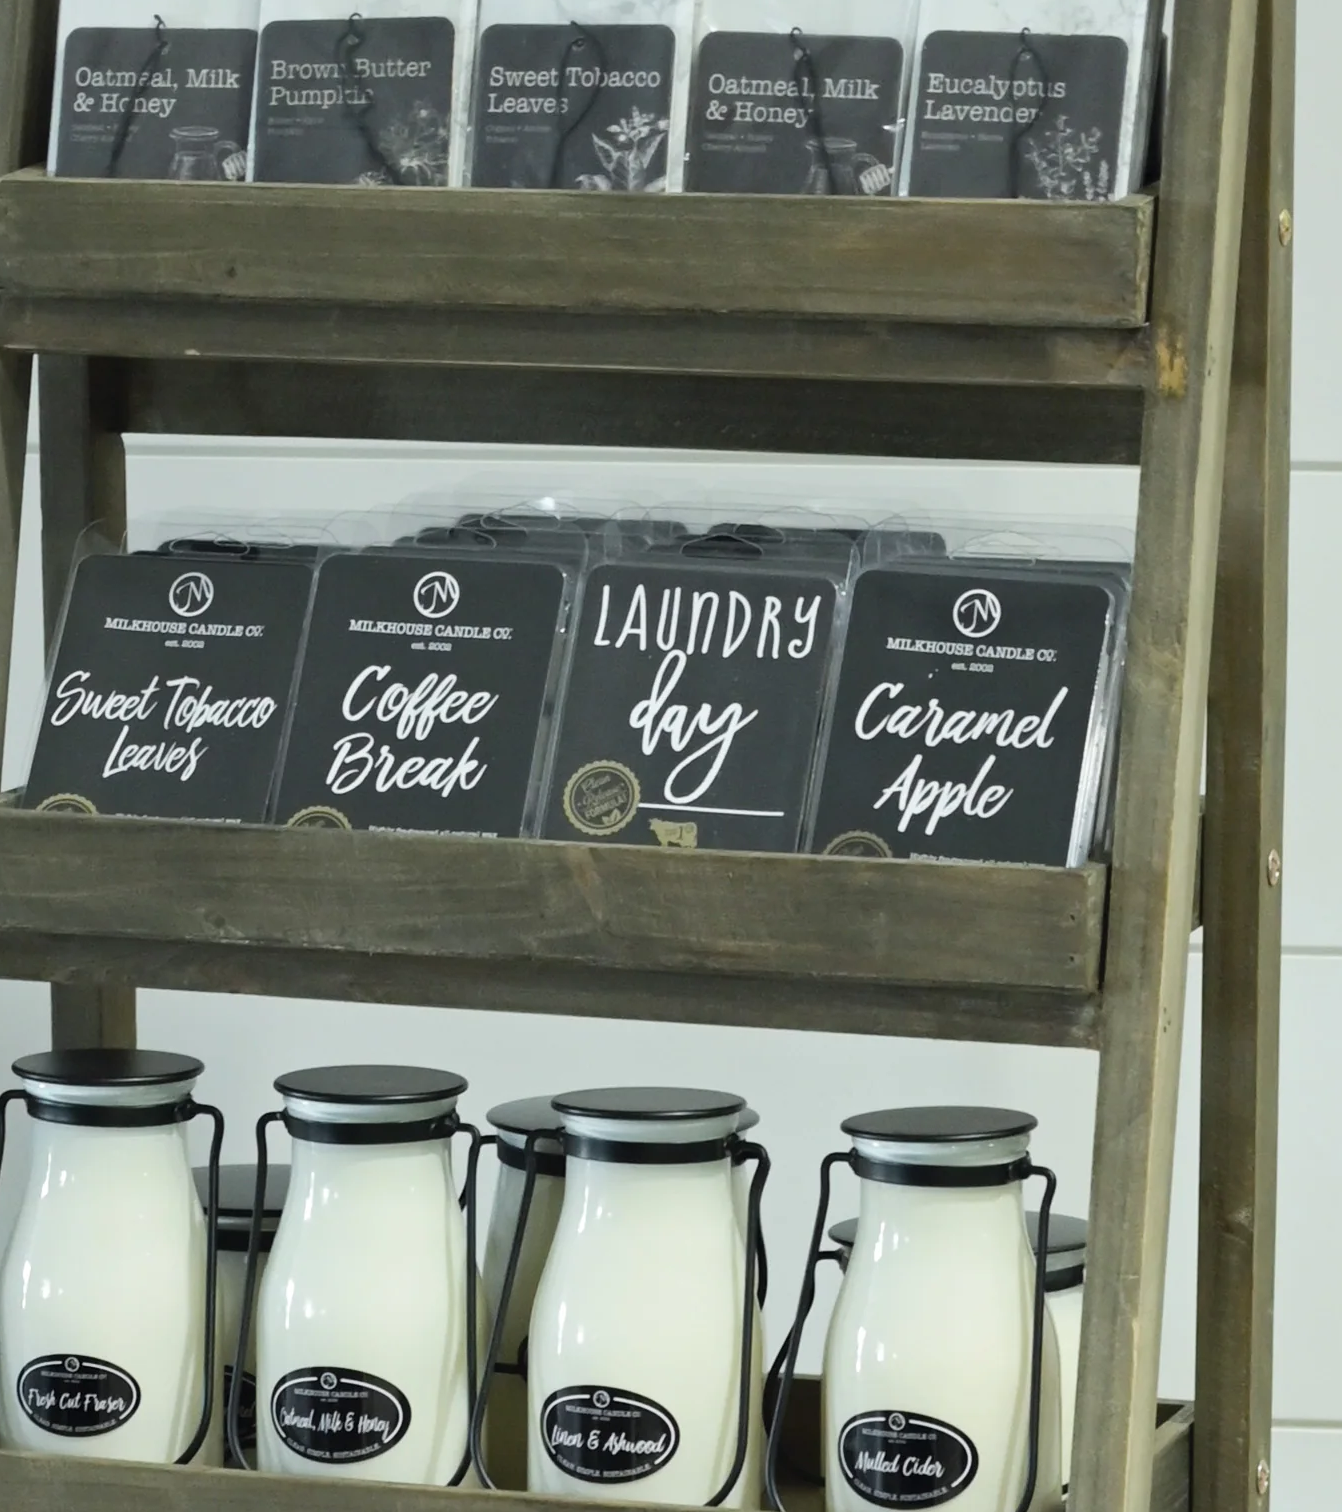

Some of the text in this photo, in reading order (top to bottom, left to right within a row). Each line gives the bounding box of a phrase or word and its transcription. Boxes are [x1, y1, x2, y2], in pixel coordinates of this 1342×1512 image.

[185, 68, 240, 89] Milk
[354, 58, 431, 78] Butter
[489, 66, 661, 88] Sweet Tobacco
[73, 92, 95, 113] &
[487, 92, 569, 114] Leaves
[822, 78, 880, 100] Milk
[706, 100, 814, 128] & Honey
[104, 617, 187, 634] MILKHOUSE
[188, 623, 243, 637] CANDLE
[349, 619, 433, 636] MILKHOUSE
[434, 624, 491, 639] CANDLE
[593, 584, 821, 660] LAUNDRY
[886, 637, 974, 656] MILKHOUSE
[976, 644, 1035, 661] CANDLE
[50, 670, 278, 733] Sweet Tobacco
[341, 664, 499, 741] Coffee
[854, 682, 1069, 749] Caramel
[629, 649, 759, 804] day
[103, 724, 209, 782] Leaves
[325, 732, 487, 798] Break
[873, 753, 1014, 836] Apple
[28, 1388, 127, 1414] Fresh Cut Fraser
[551, 1424, 667, 1456] Linen & Ashwood
[855, 1450, 945, 1478] Mulled Cider
